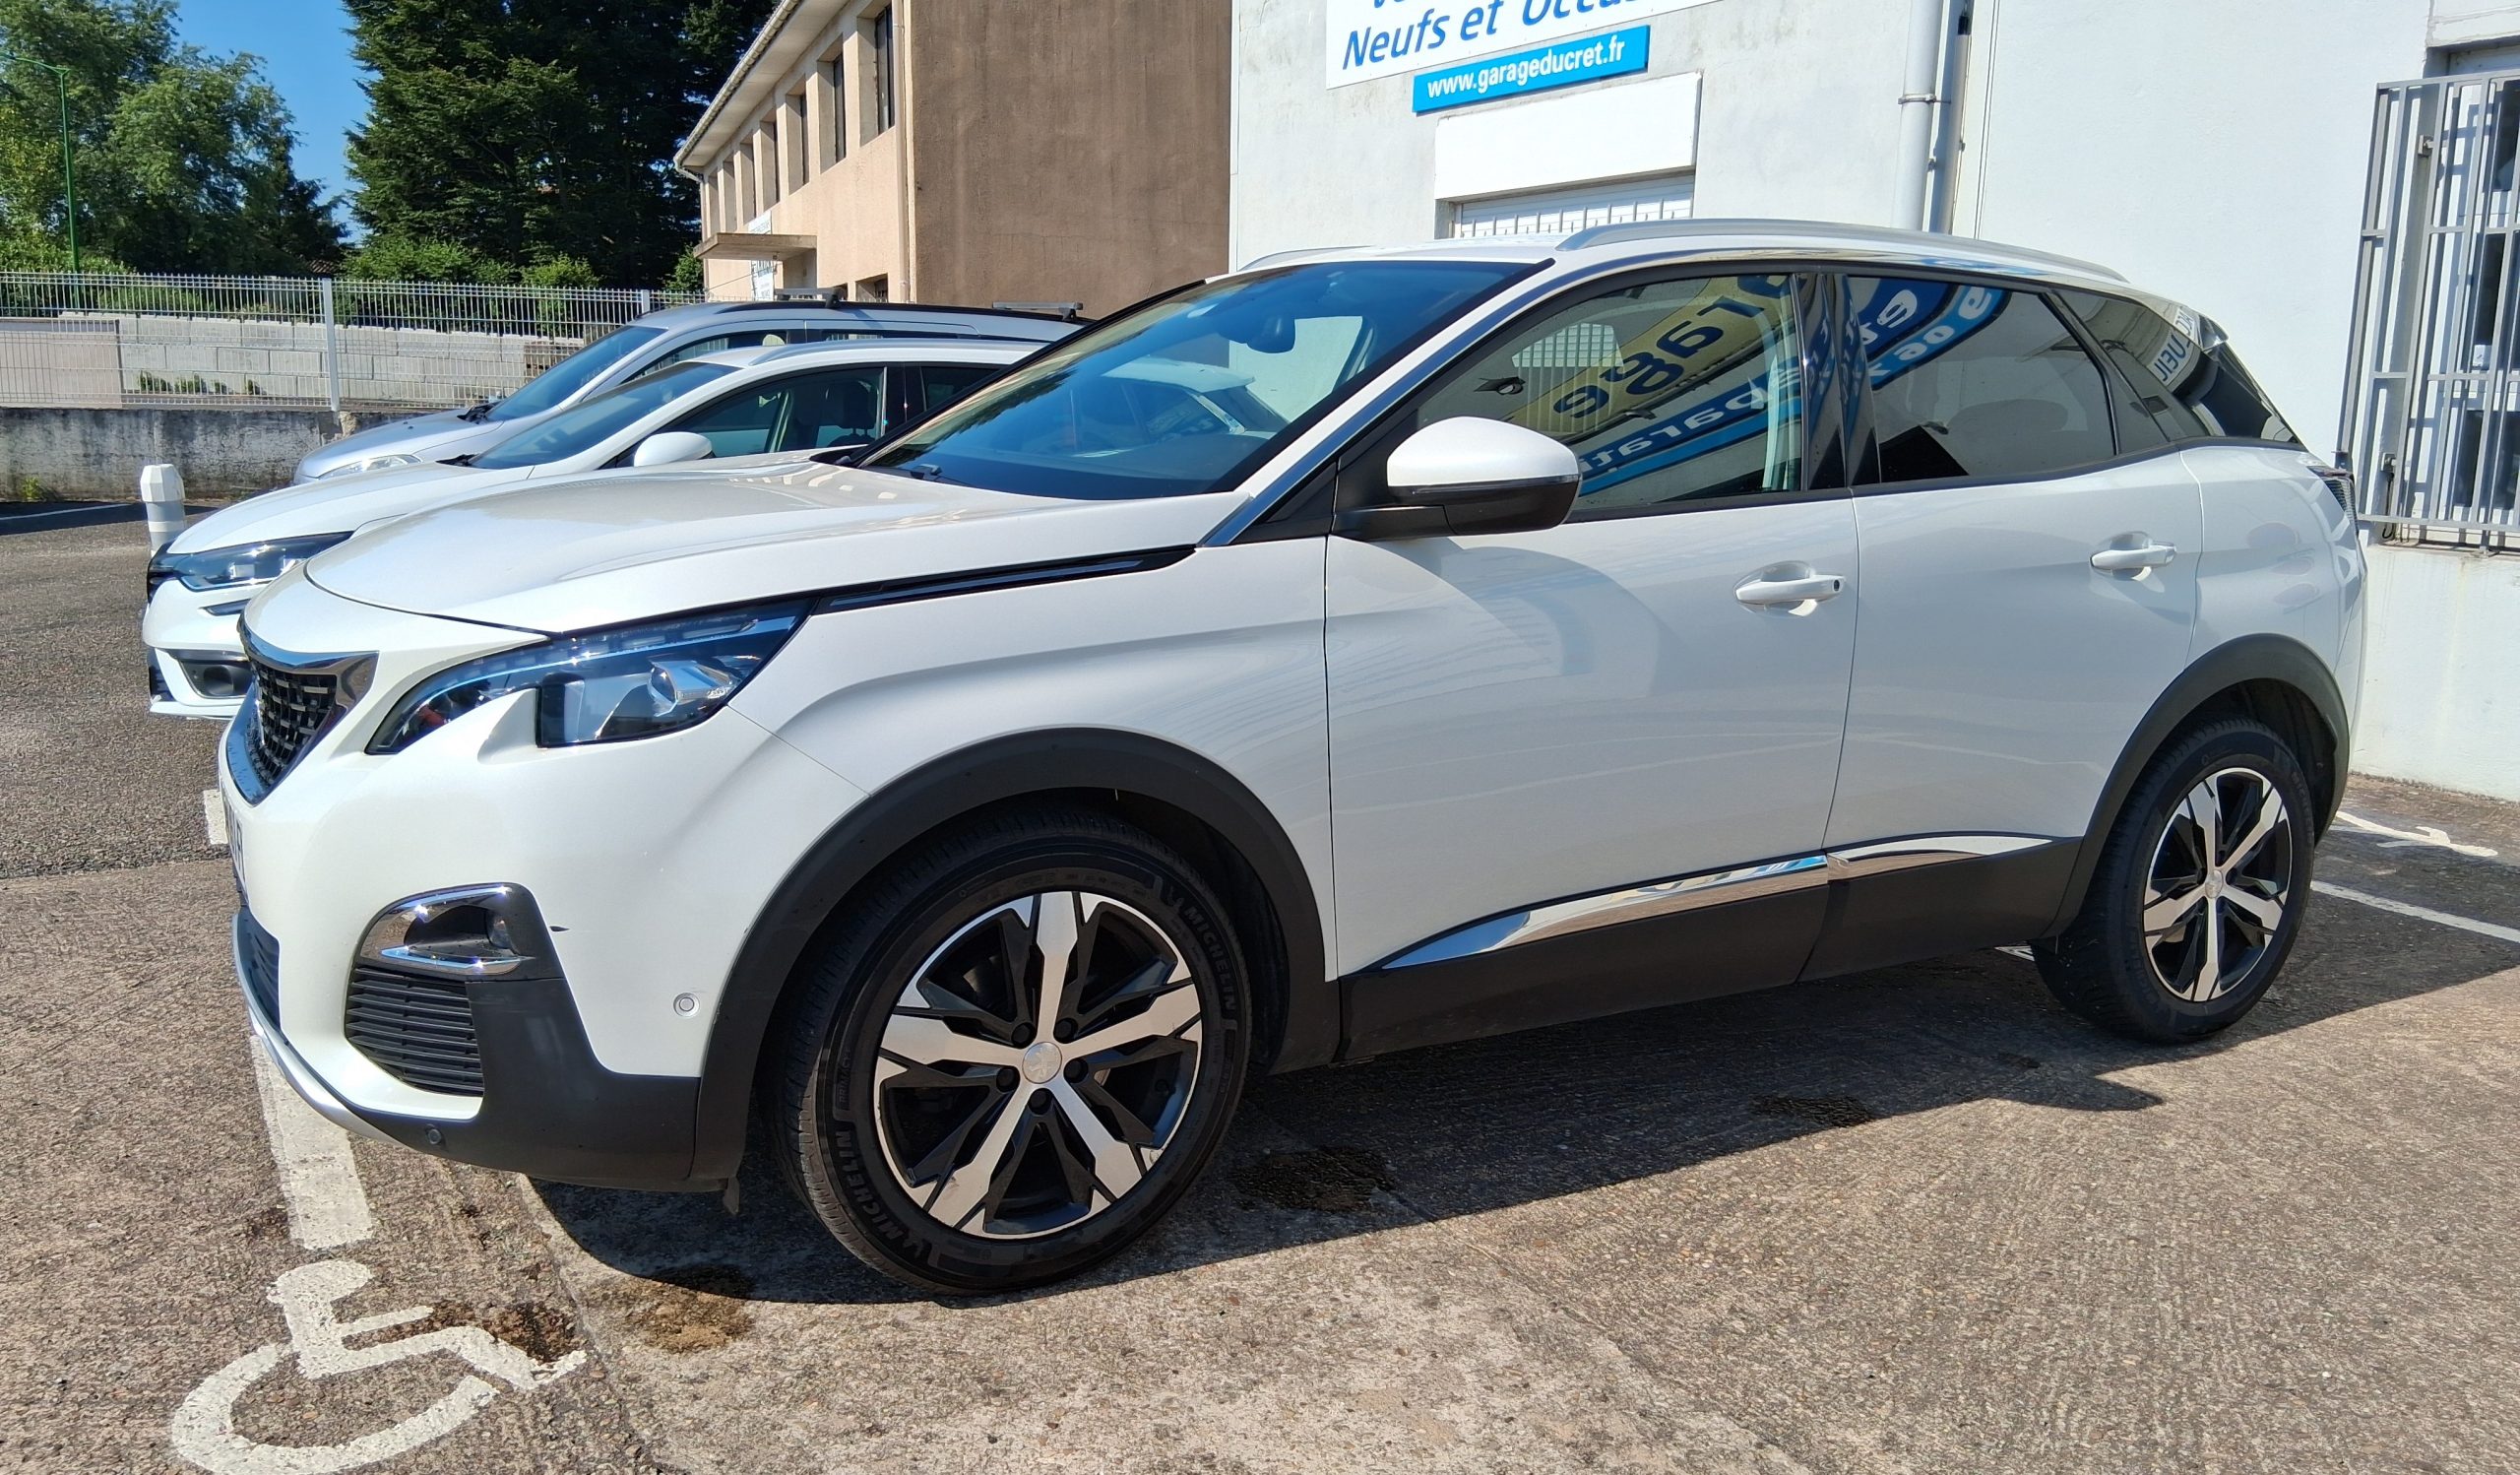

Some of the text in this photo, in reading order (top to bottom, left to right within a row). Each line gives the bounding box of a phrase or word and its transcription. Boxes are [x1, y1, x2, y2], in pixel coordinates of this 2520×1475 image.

[1343, 8, 1450, 70] Neufs
[1461, 0, 1504, 41] et
[1427, 34, 1625, 97] www.garageducret.fr
[1183, 906, 1236, 1014] MICHELIN
[835, 1131, 903, 1240] MICHELIN
